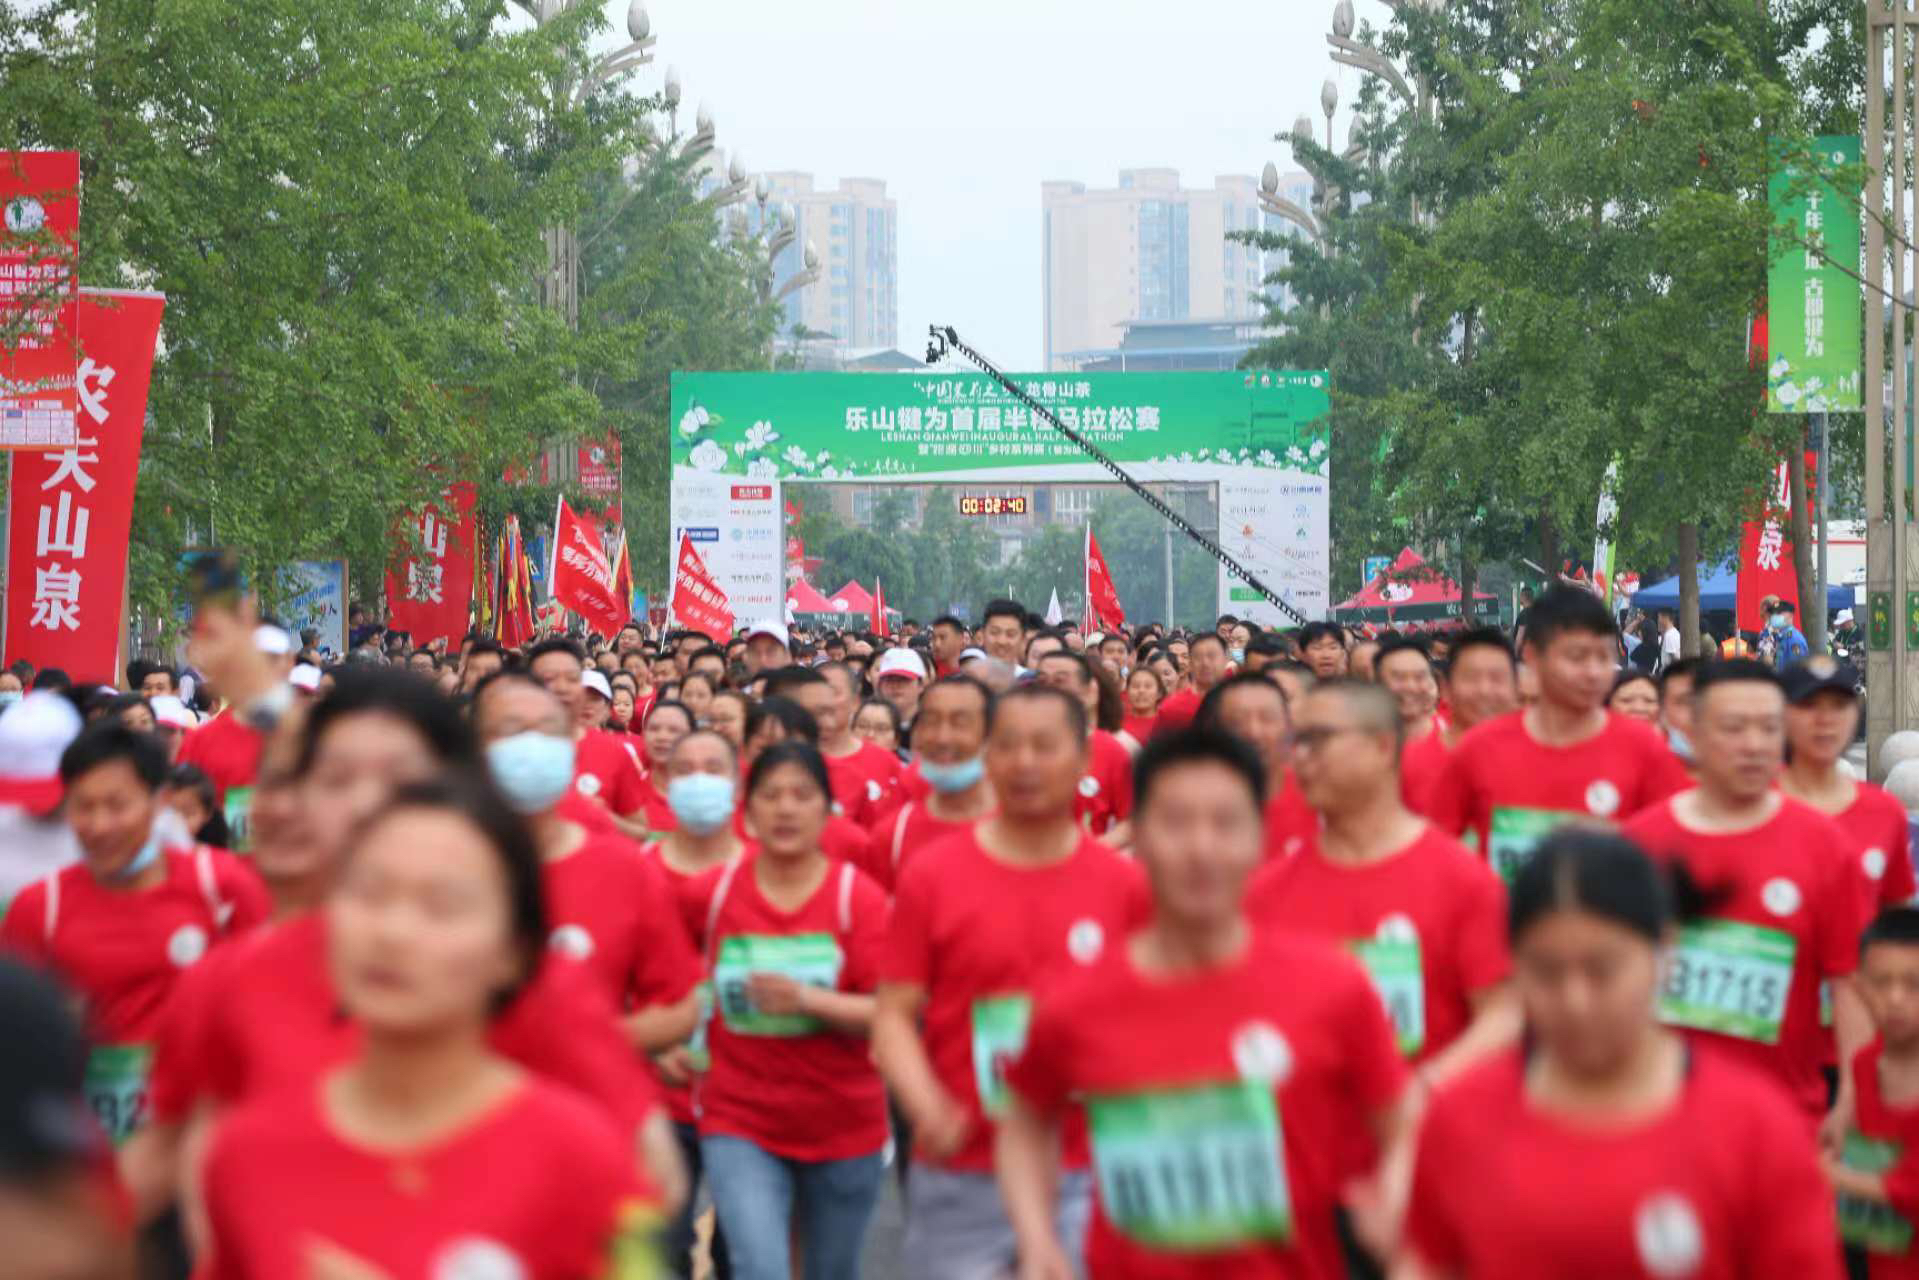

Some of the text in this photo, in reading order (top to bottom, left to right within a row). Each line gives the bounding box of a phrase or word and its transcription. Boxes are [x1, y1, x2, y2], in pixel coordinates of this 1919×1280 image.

[881, 431, 921, 441] LESHAN
[923, 431, 970, 441] QIANWEI
[971, 431, 1030, 441] INAUGURAL
[1035, 431, 1061, 441] HALF
[962, 498, 1024, 514] 00:02:40
